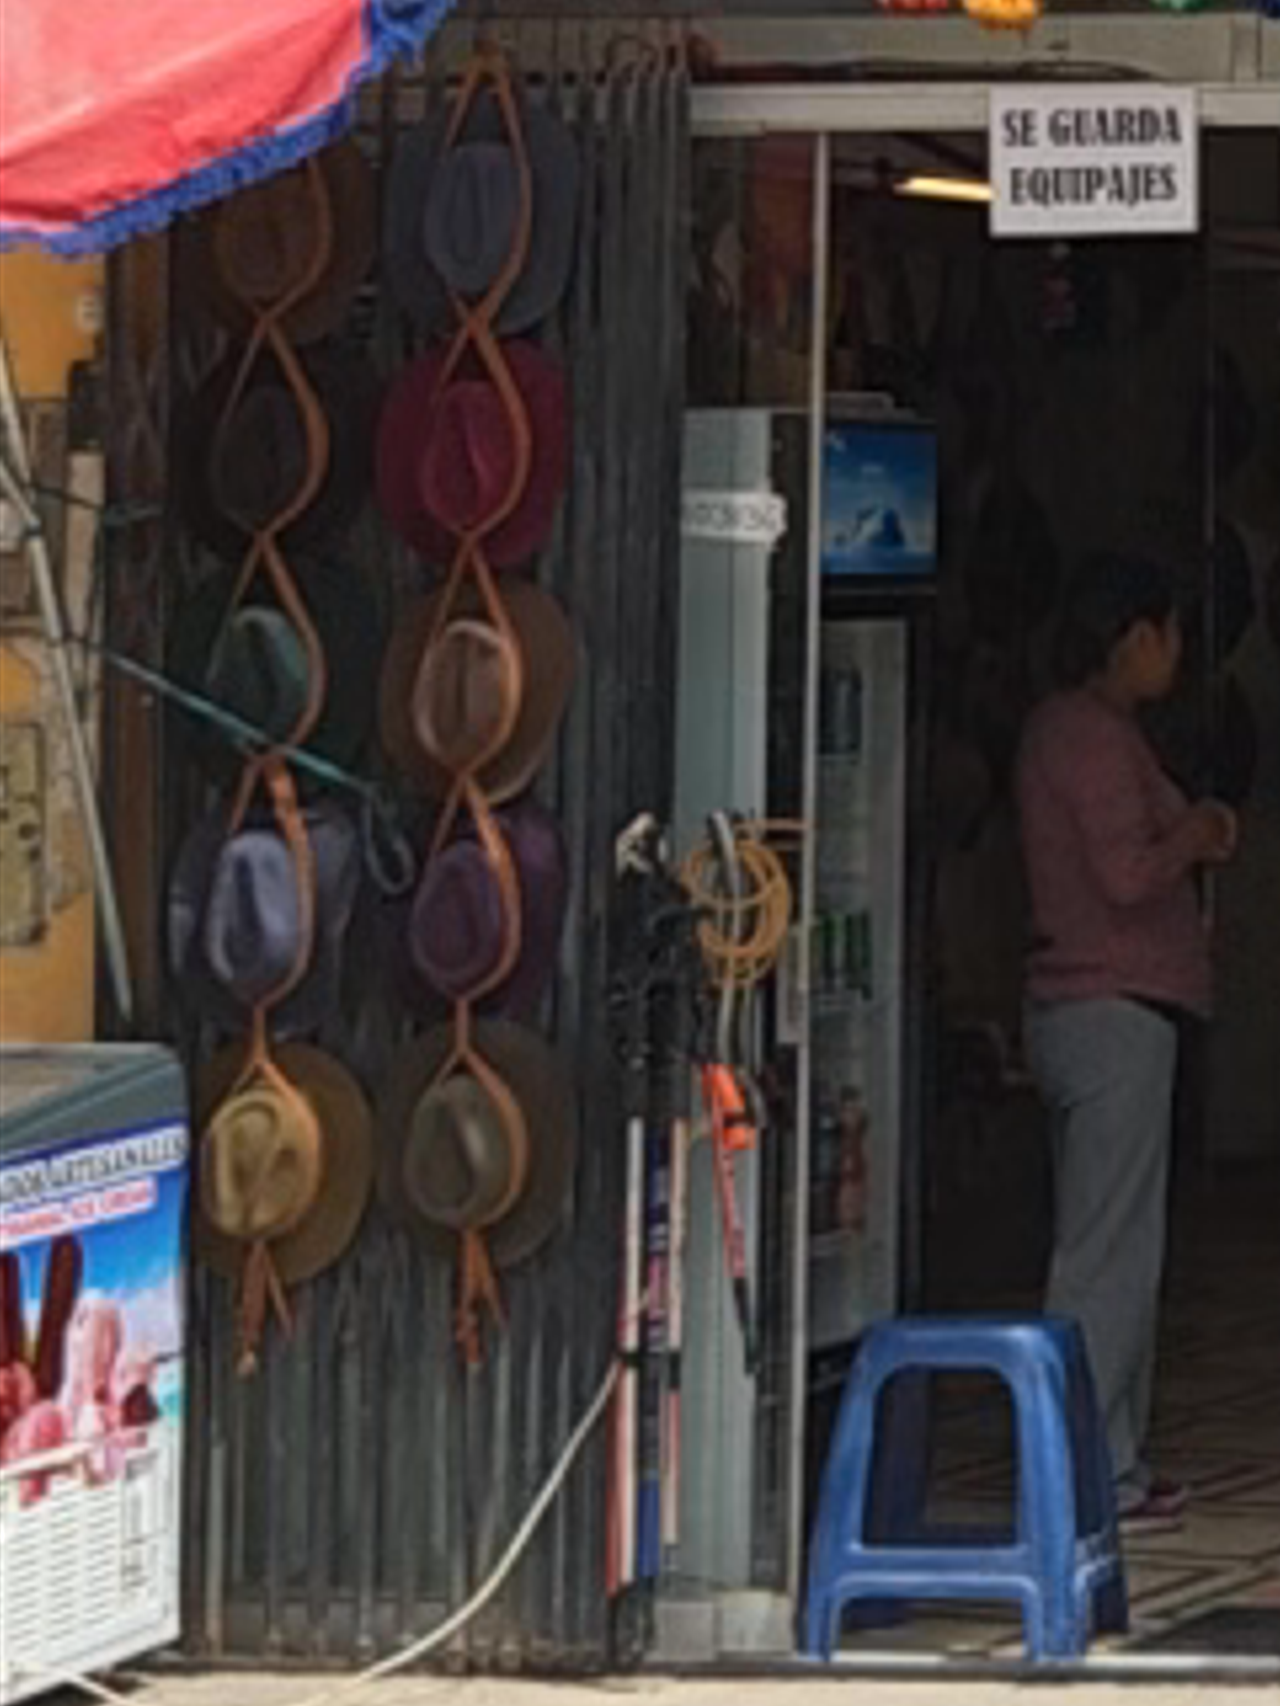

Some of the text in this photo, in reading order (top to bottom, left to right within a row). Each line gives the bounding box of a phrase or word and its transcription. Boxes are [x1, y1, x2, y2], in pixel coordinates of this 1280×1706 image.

[1002, 106, 1183, 147] SE GUARDA
[1010, 164, 1179, 207] EQUIPAJES
